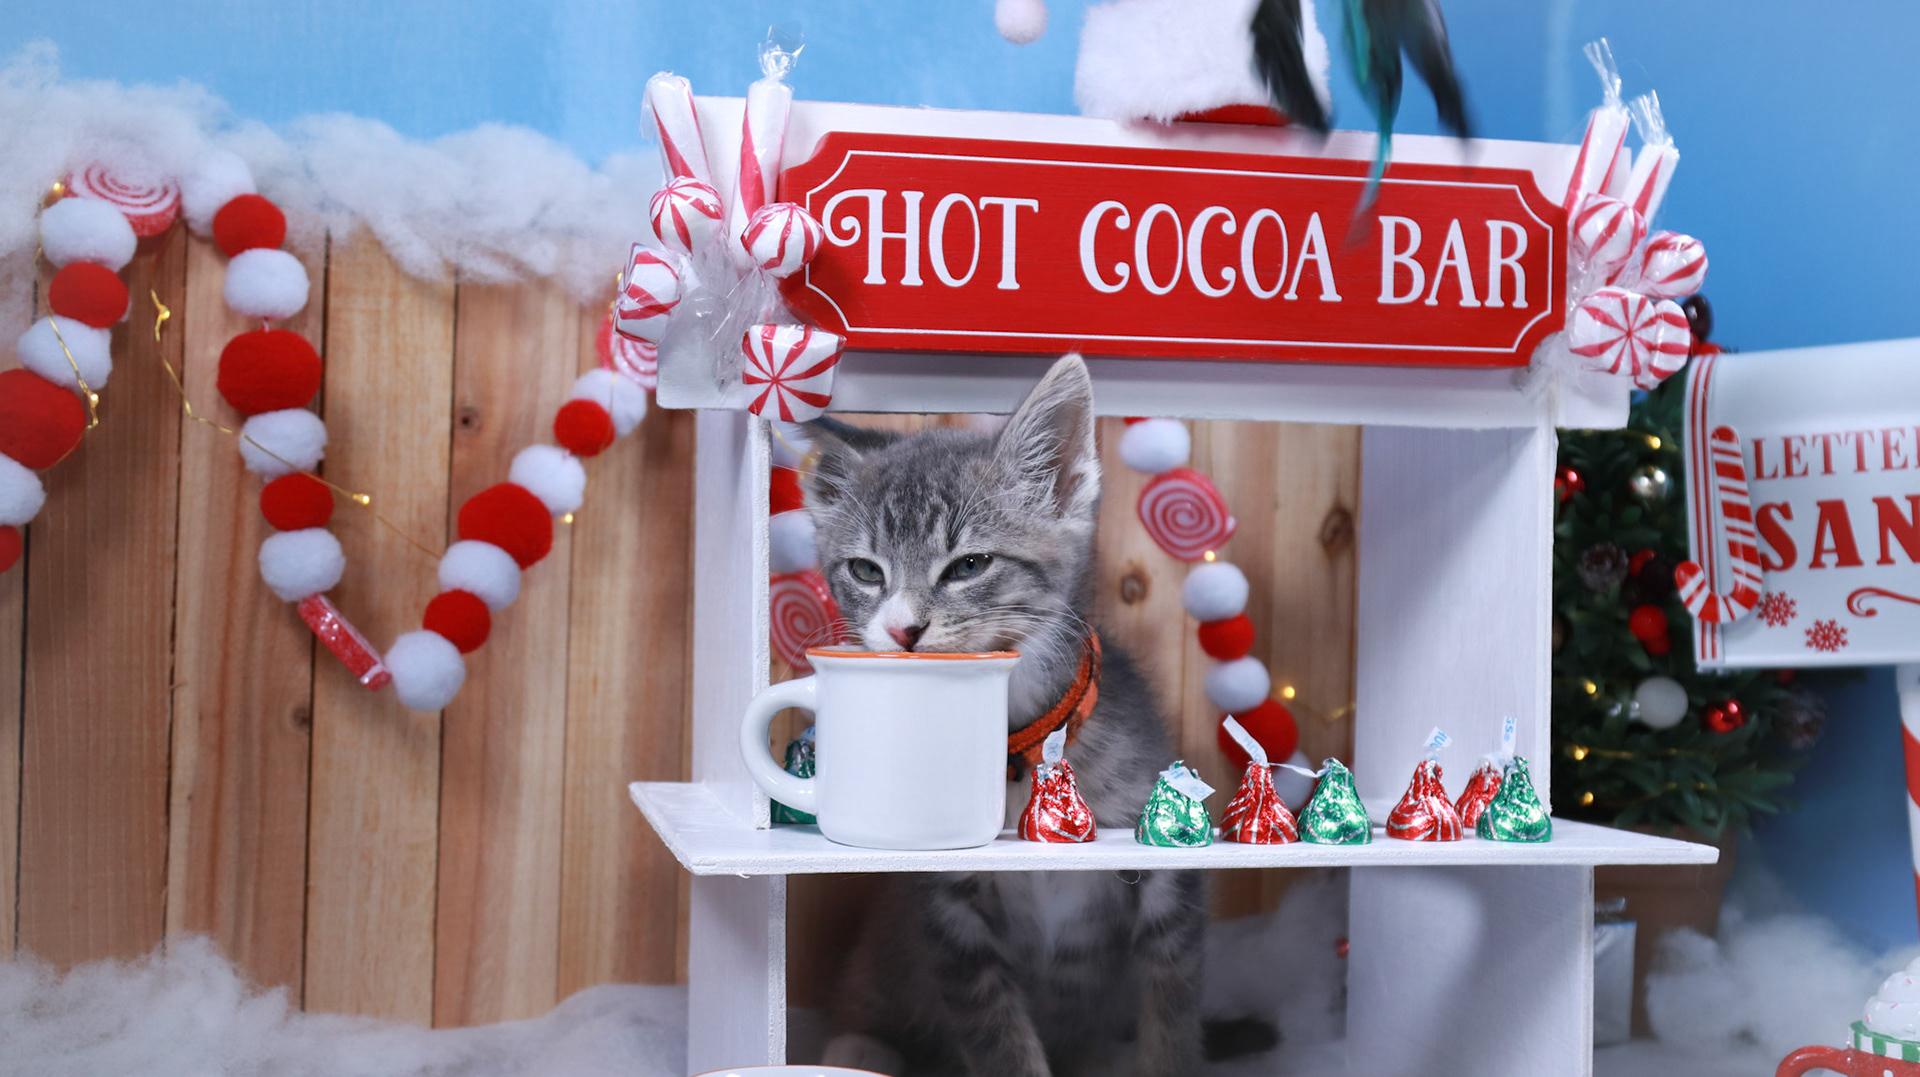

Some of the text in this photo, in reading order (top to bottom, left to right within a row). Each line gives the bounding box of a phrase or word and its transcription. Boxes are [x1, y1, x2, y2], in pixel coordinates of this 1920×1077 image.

[821, 189, 1529, 309] HOT COCOA BAR
